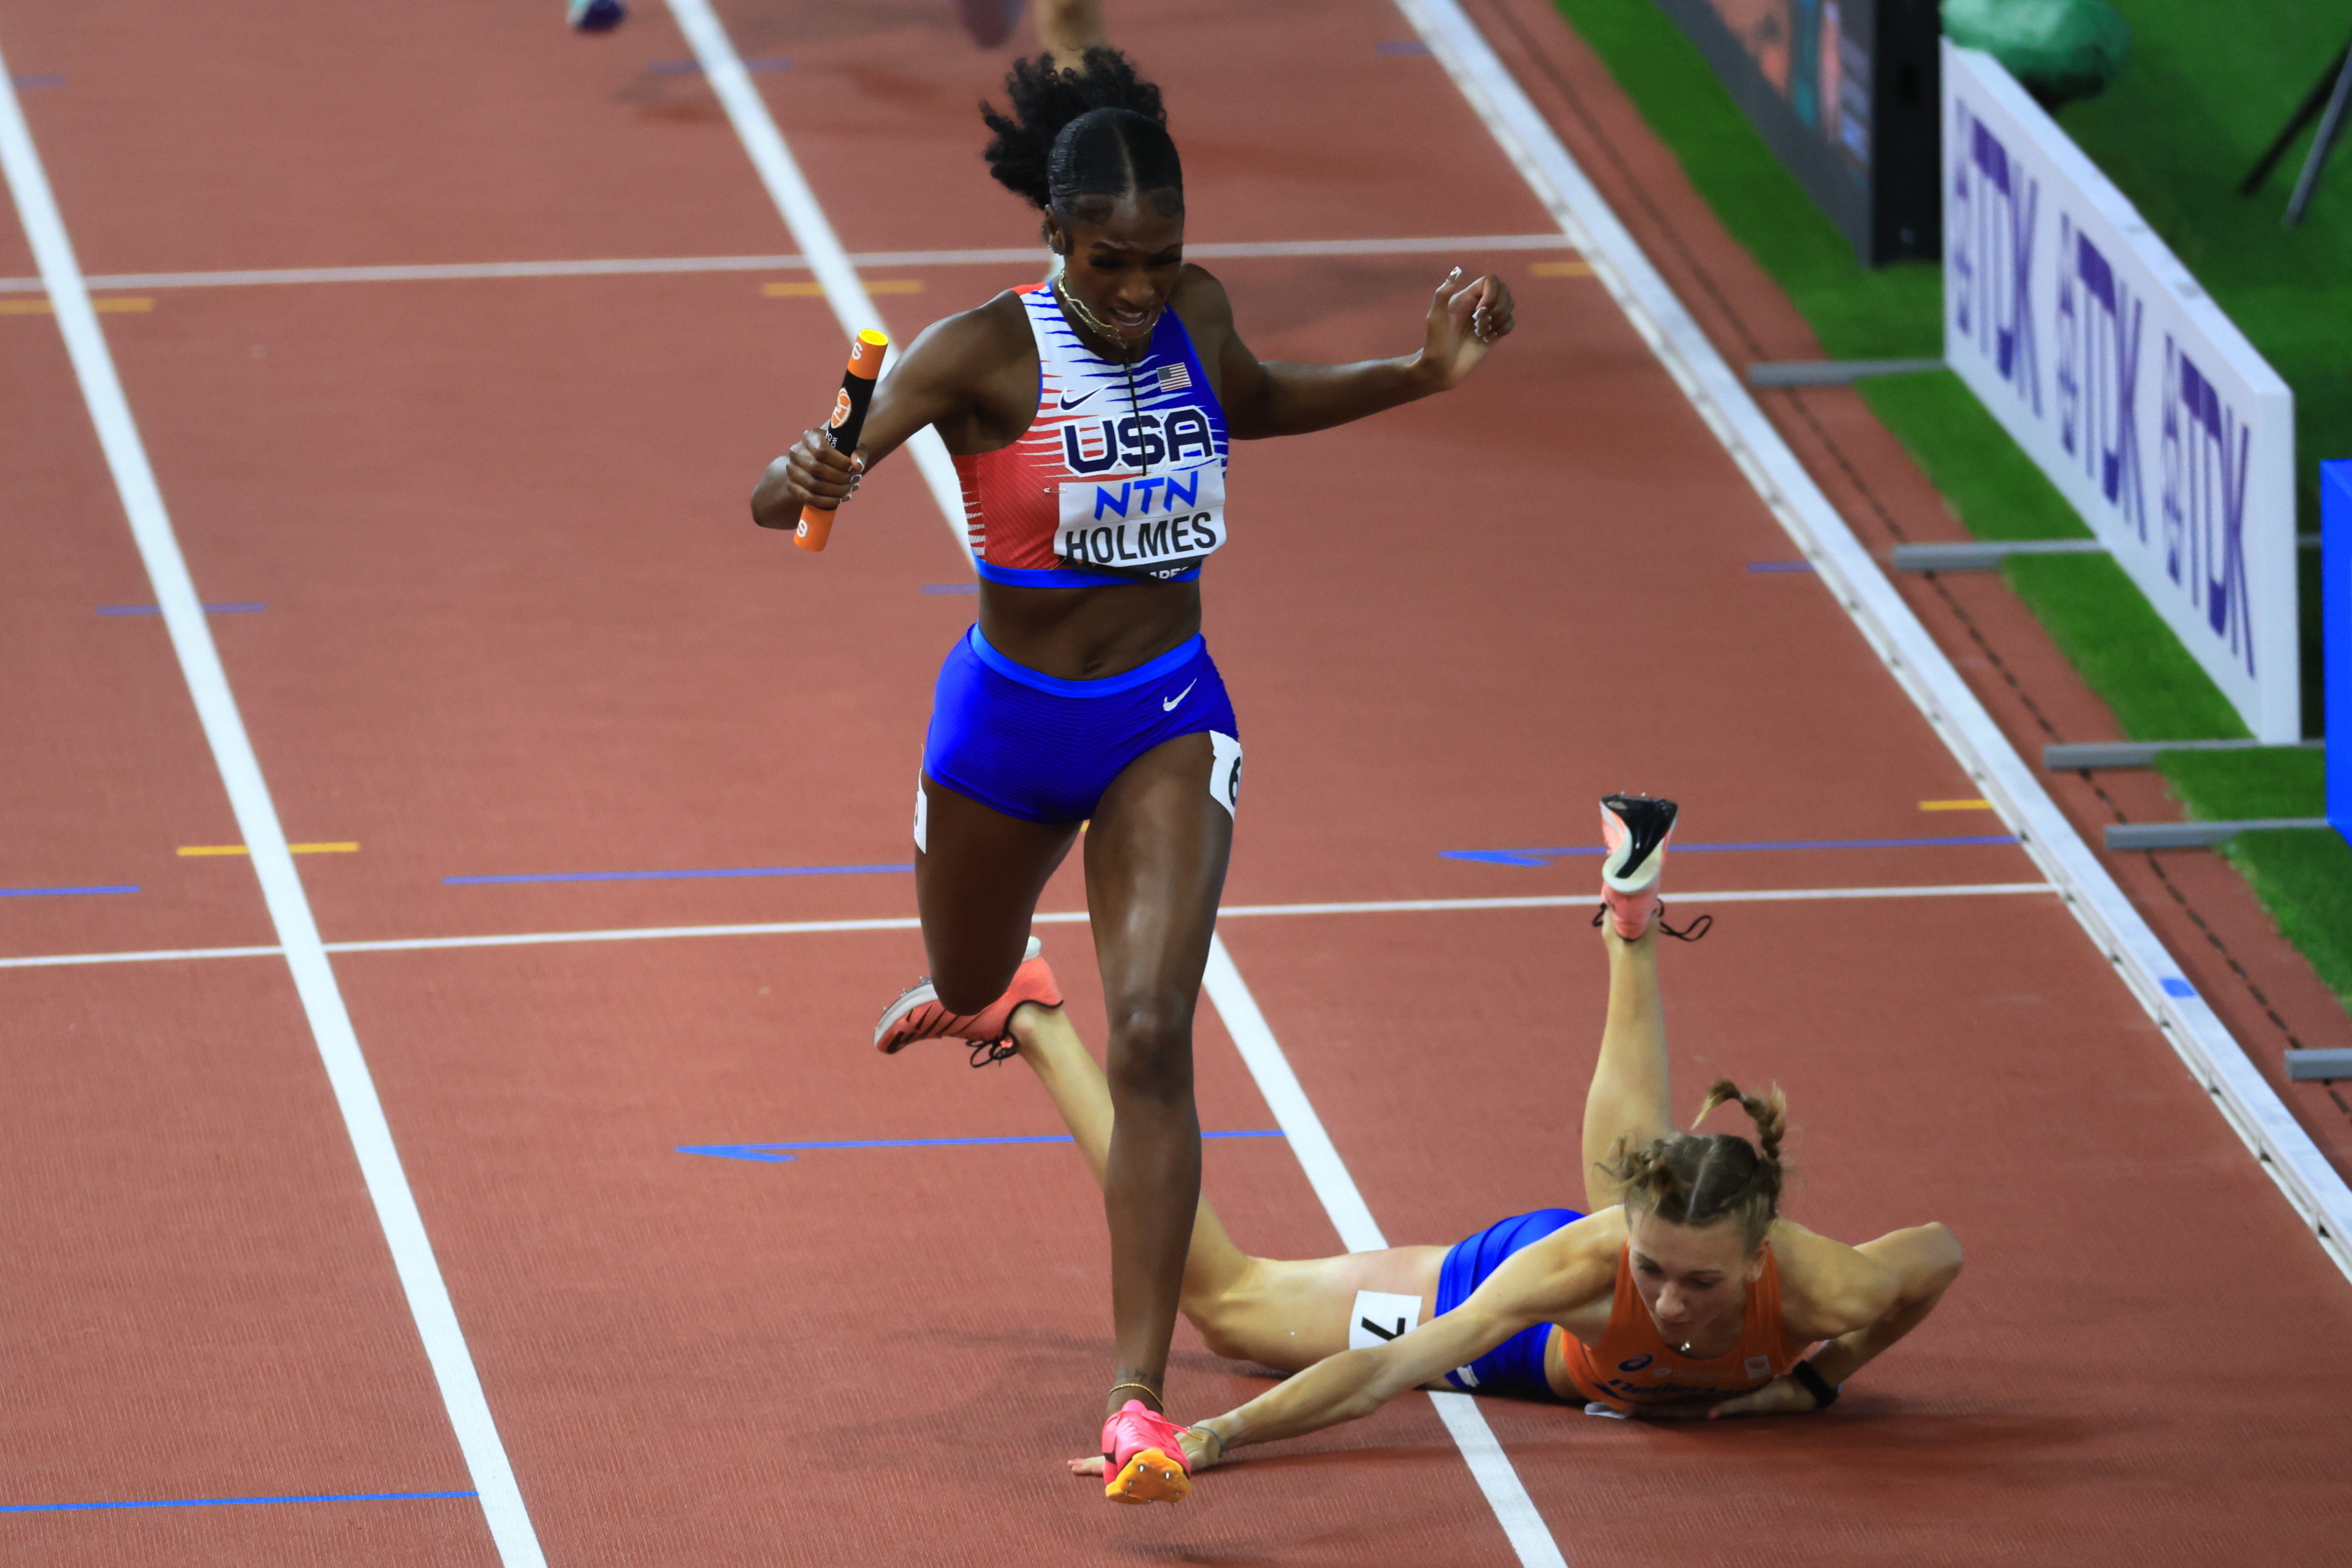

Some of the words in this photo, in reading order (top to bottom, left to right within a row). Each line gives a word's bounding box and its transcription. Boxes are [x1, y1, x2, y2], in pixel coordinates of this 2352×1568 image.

[1062, 407, 1213, 475] USA
[1094, 471, 1198, 521] NTN
[1065, 511, 1216, 564] HOLMES
[1361, 1316, 1406, 1341] 7
